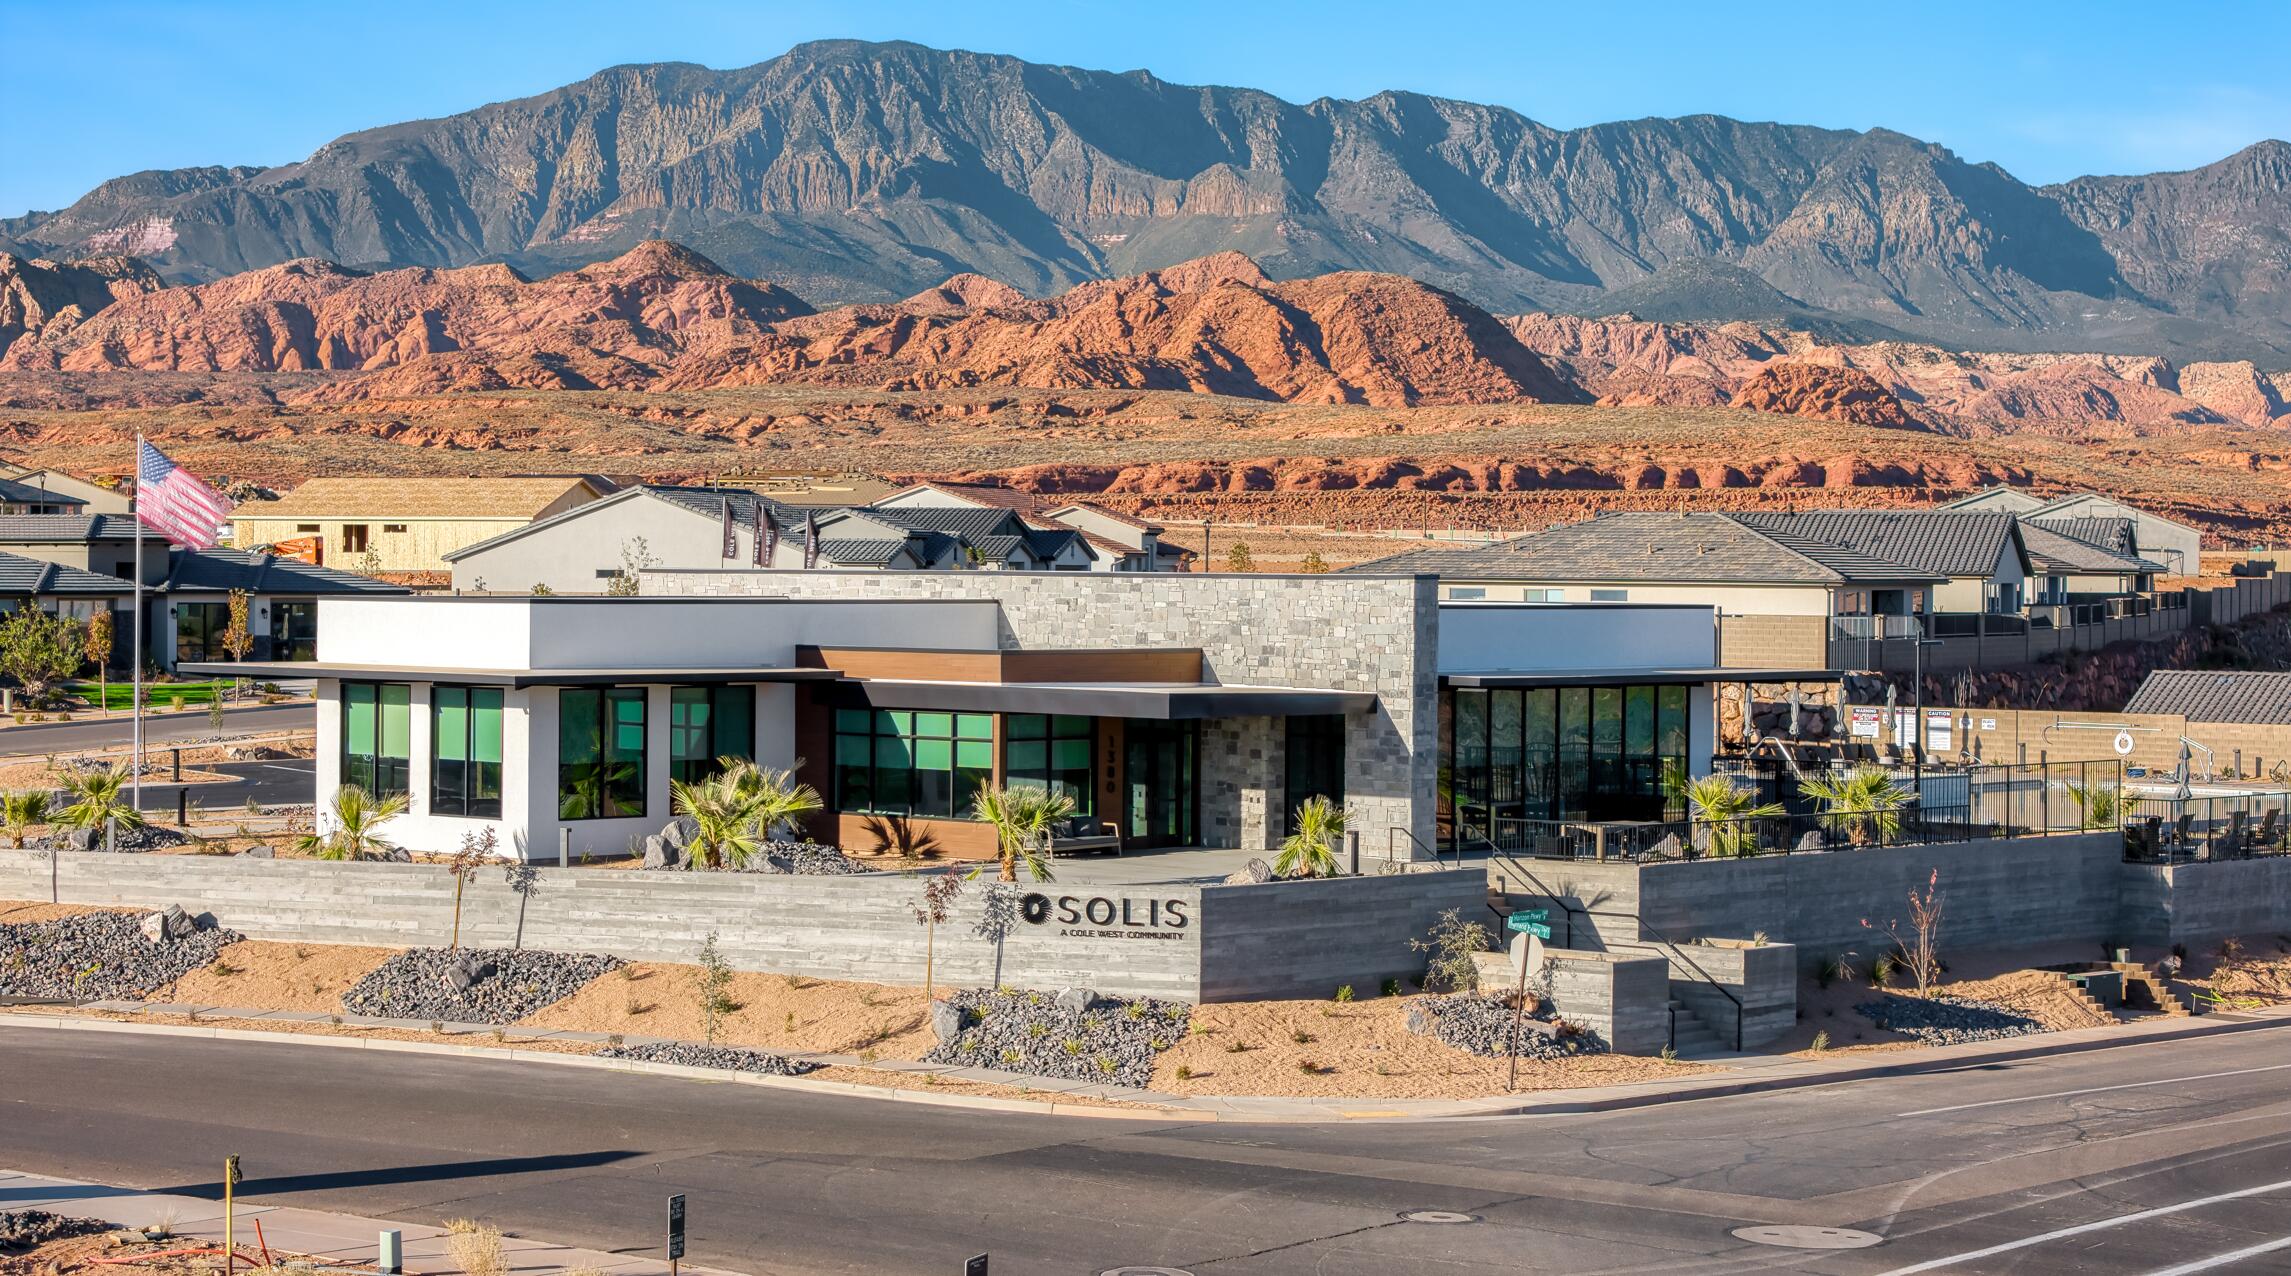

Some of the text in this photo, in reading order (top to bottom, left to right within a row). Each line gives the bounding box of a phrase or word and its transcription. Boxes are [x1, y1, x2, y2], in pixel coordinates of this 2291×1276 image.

[728, 539, 736, 556] COLE
[1057, 895, 1188, 928] SOLIS
[1069, 929, 1095, 938] COLE
[1097, 930, 1125, 939] WEST
[1126, 931, 1185, 940] COMMUNITY
